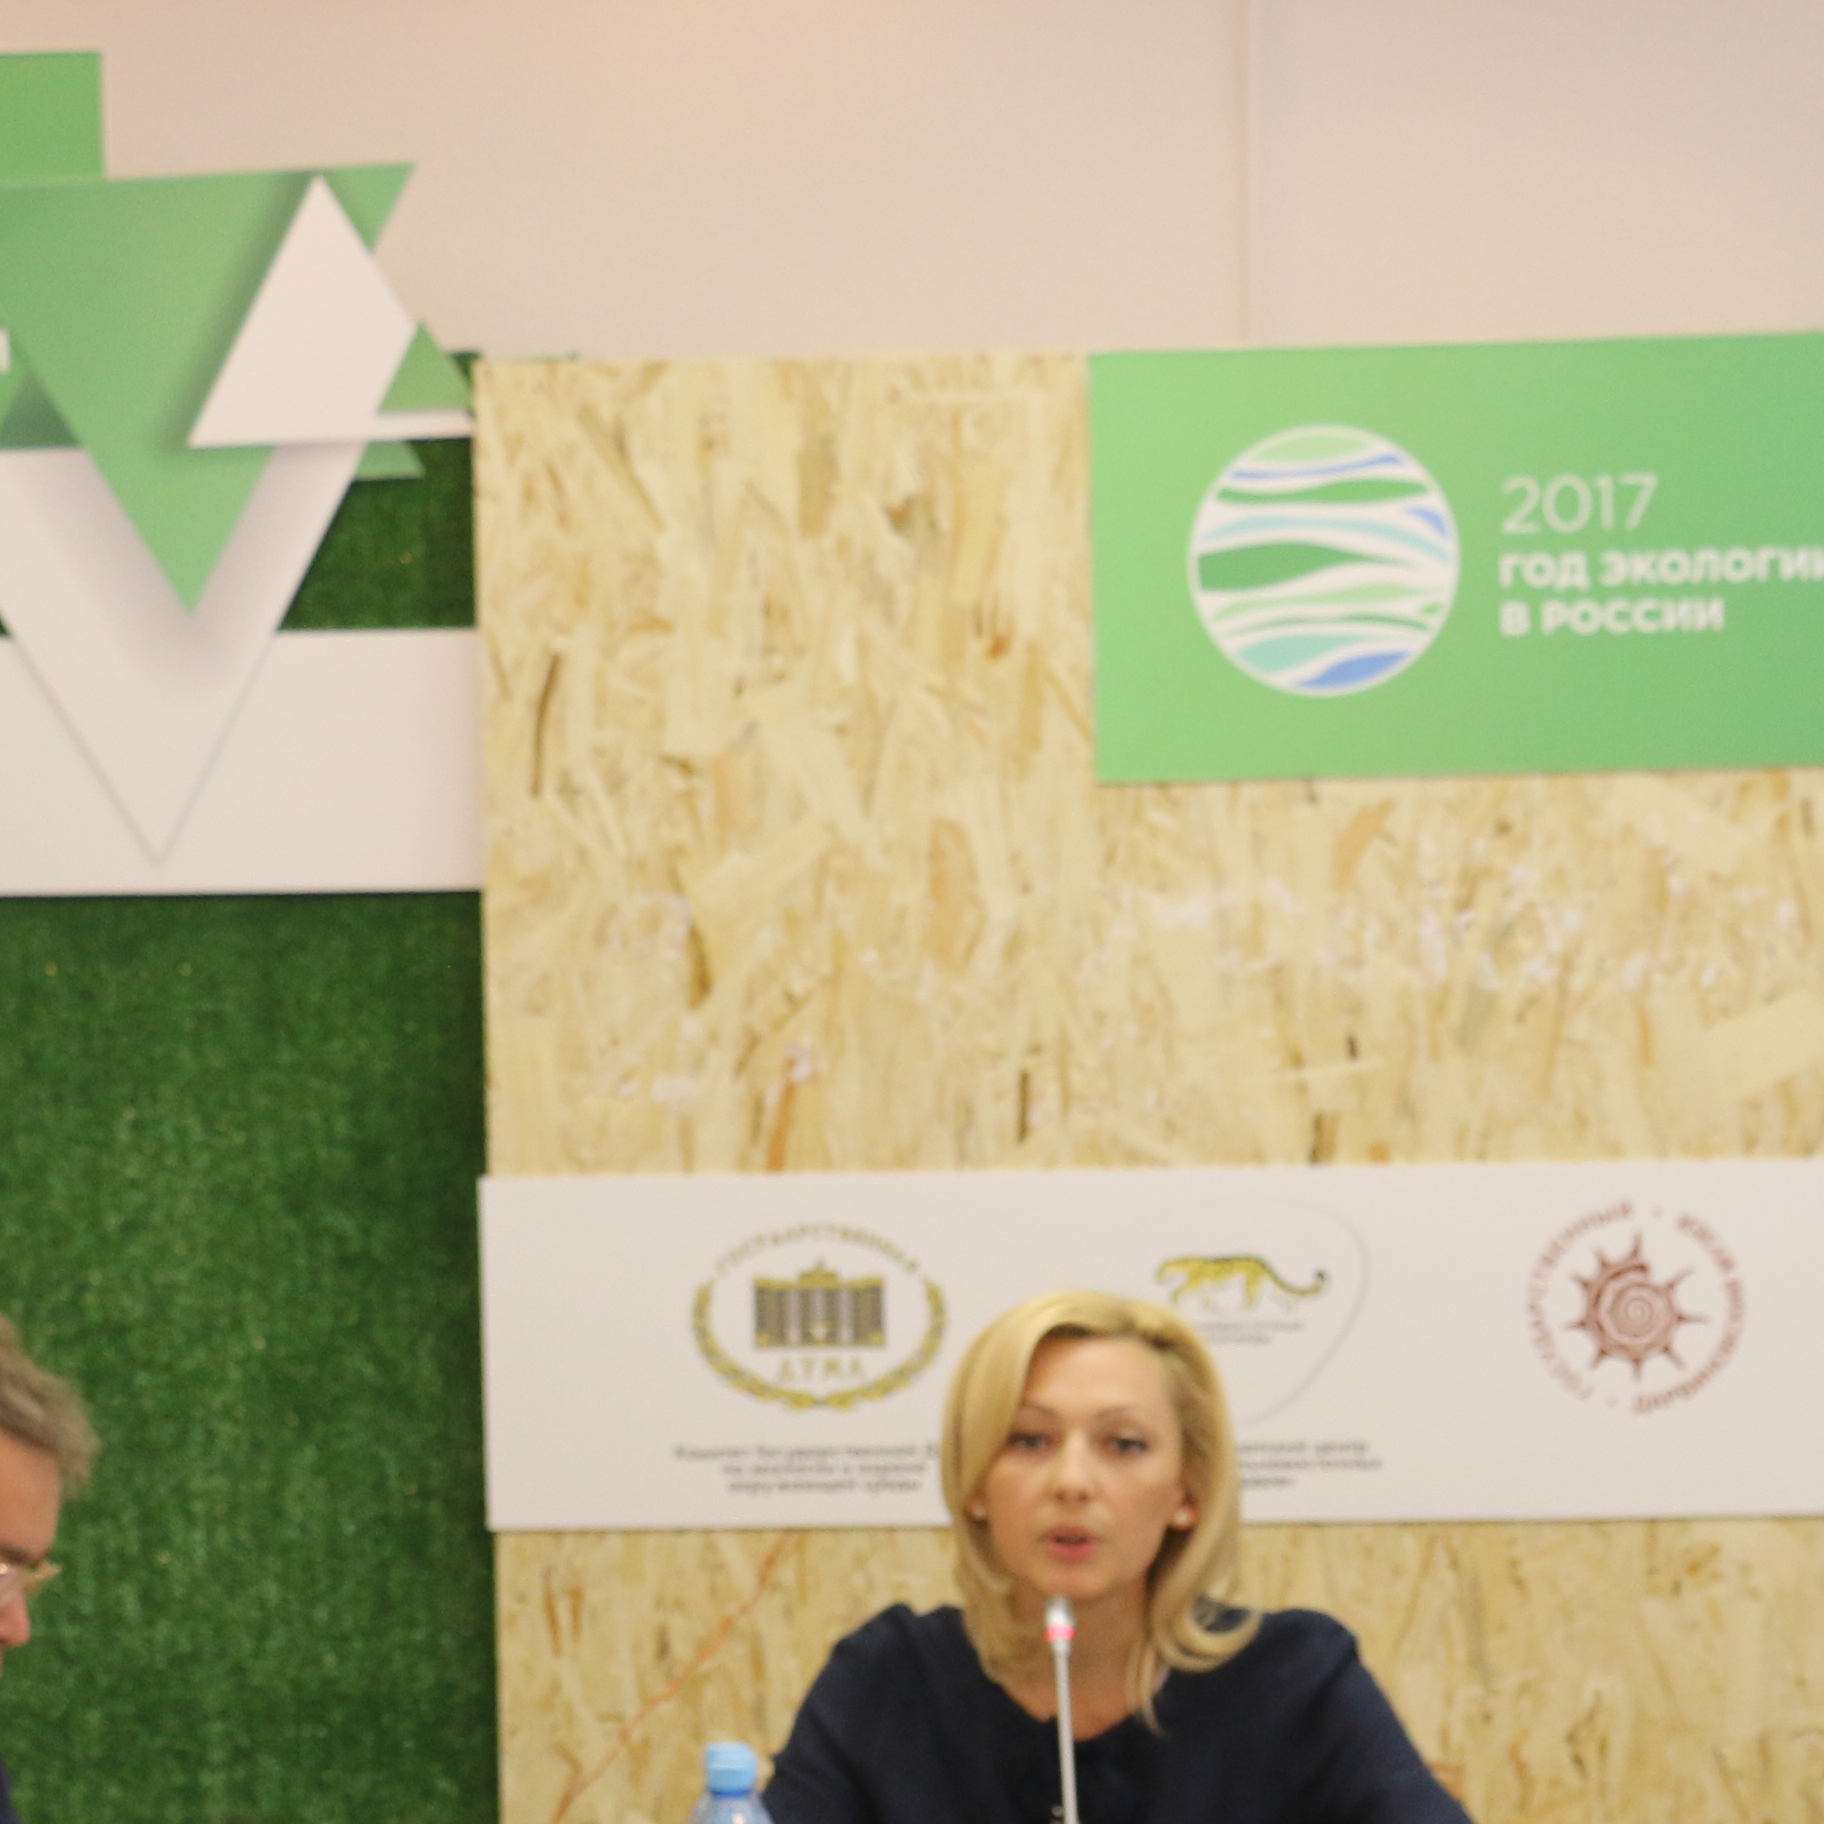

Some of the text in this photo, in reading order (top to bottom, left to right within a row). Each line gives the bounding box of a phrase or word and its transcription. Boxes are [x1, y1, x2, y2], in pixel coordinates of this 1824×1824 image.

[1499, 473, 1659, 534] 2017
[1499, 550, 1590, 590] ГОД
[1499, 596, 1724, 636] В РОССИИ
